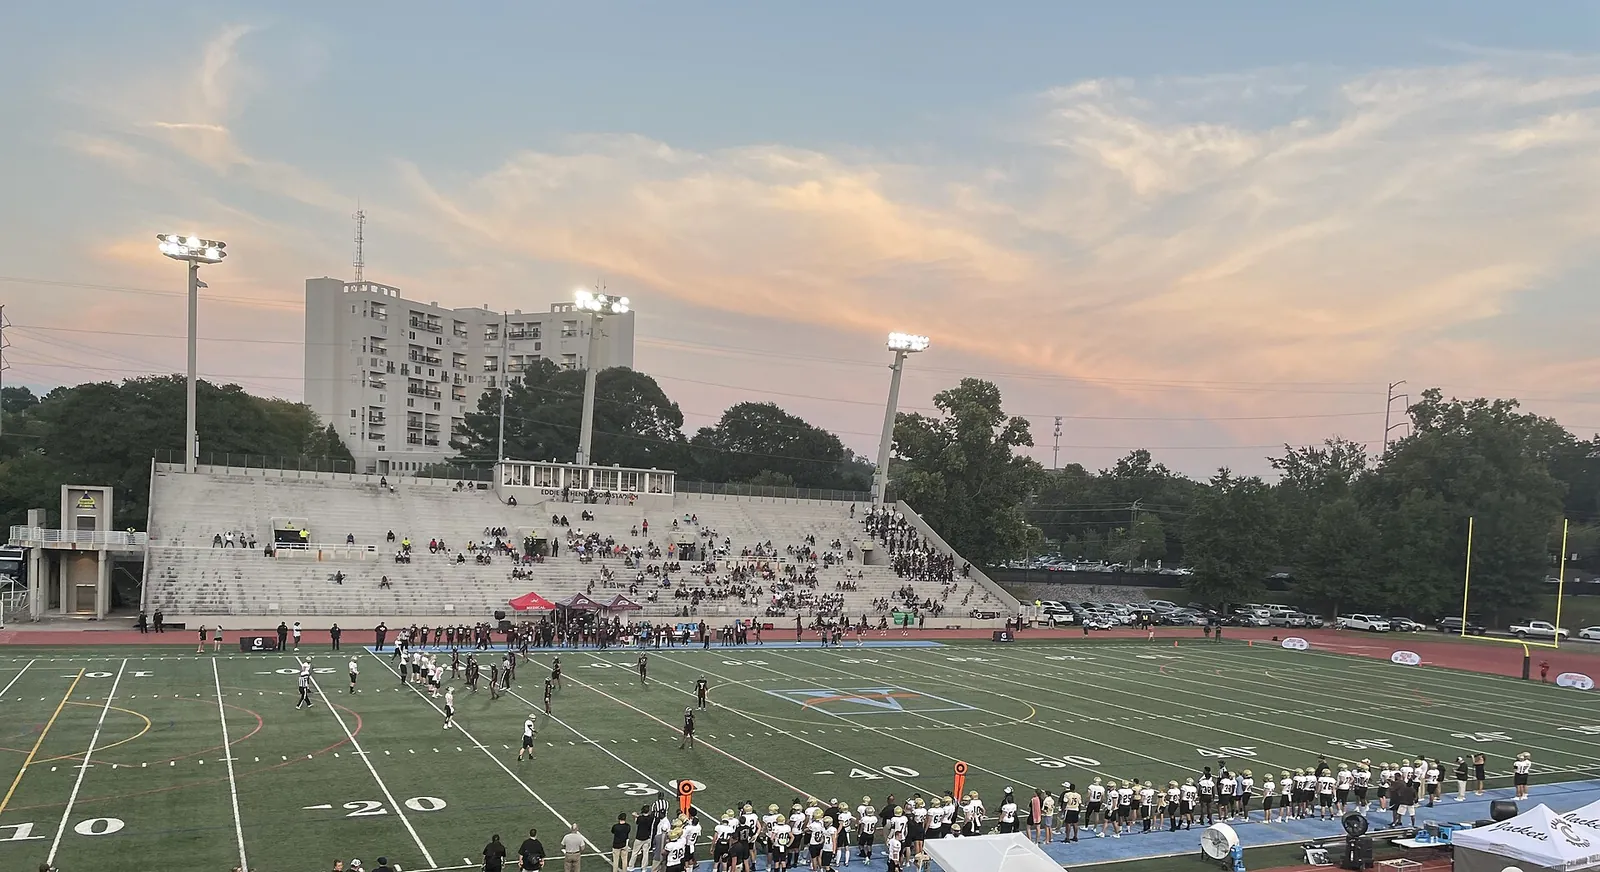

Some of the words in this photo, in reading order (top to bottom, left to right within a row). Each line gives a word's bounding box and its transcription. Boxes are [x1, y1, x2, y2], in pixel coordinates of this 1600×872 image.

[571, 490, 610, 499] HENDSO
[254, 638, 263, 646] G
[1489, 822, 1549, 841] Jackets
